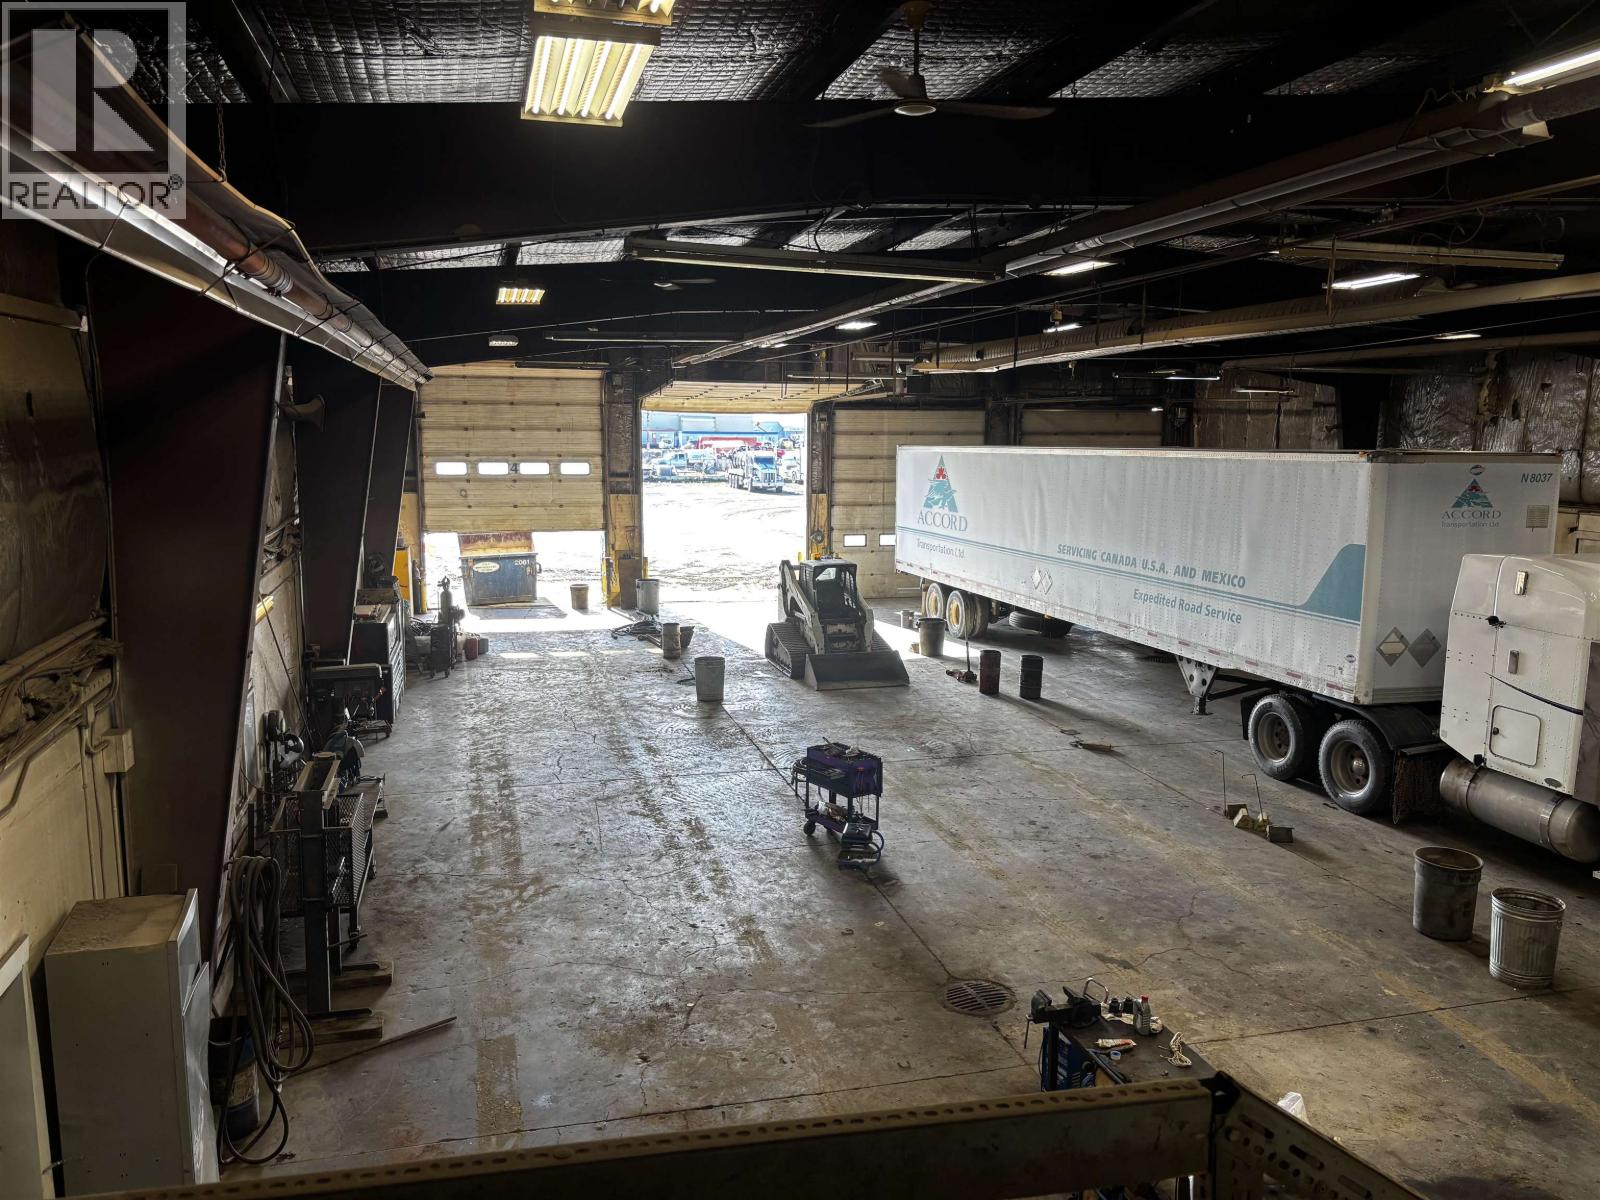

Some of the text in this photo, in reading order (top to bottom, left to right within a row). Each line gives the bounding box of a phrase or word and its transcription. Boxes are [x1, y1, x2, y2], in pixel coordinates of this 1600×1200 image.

[510, 462, 519, 474] 4
[917, 509, 968, 532] ACCORD
[1441, 509, 1502, 520] ACCORD
[1441, 520, 1488, 529] Transportation
[916, 538, 954, 557] Transportation
[1057, 543, 1247, 589] SERVICING CANADA U.S.A. AND MEXICO
[1133, 588, 1243, 625] Expedited Road Service
